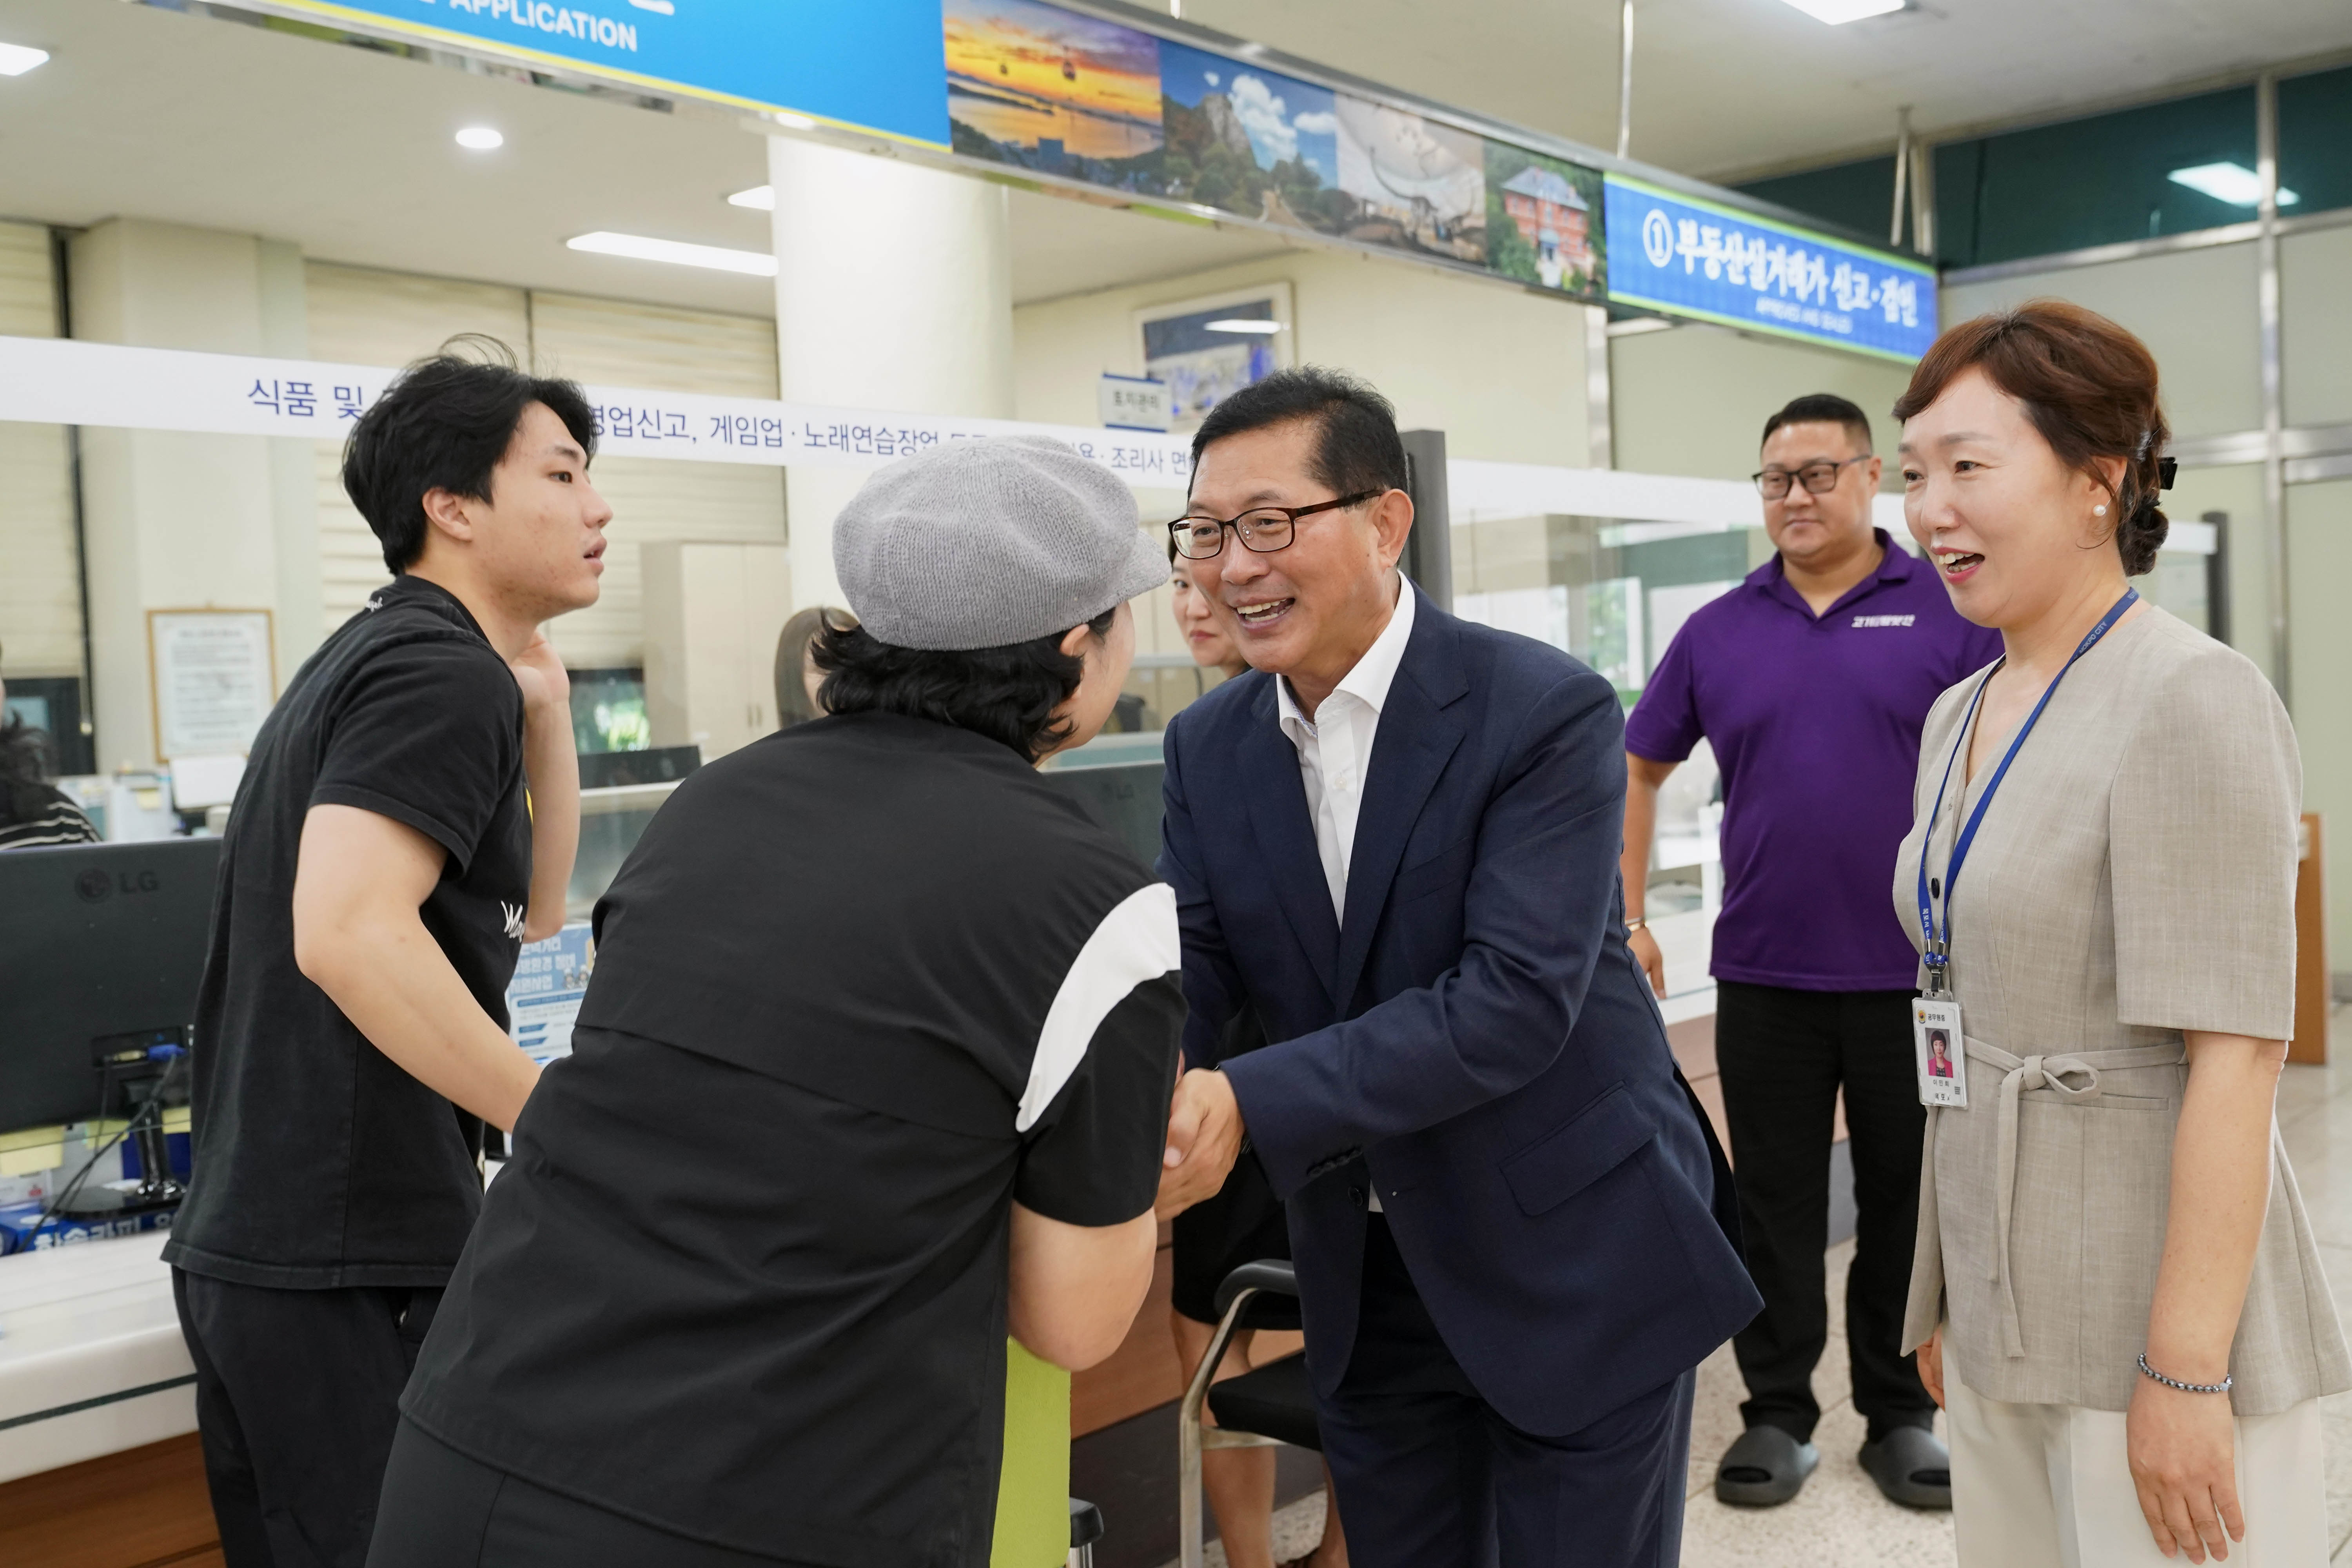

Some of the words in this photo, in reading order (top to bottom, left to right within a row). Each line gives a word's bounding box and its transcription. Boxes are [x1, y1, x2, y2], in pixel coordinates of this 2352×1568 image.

[248, 379, 318, 417] 식품
[334, 385, 365, 420] 및
[119, 870, 160, 894] LG
[1927, 1013, 1945, 1022] 공무원증
